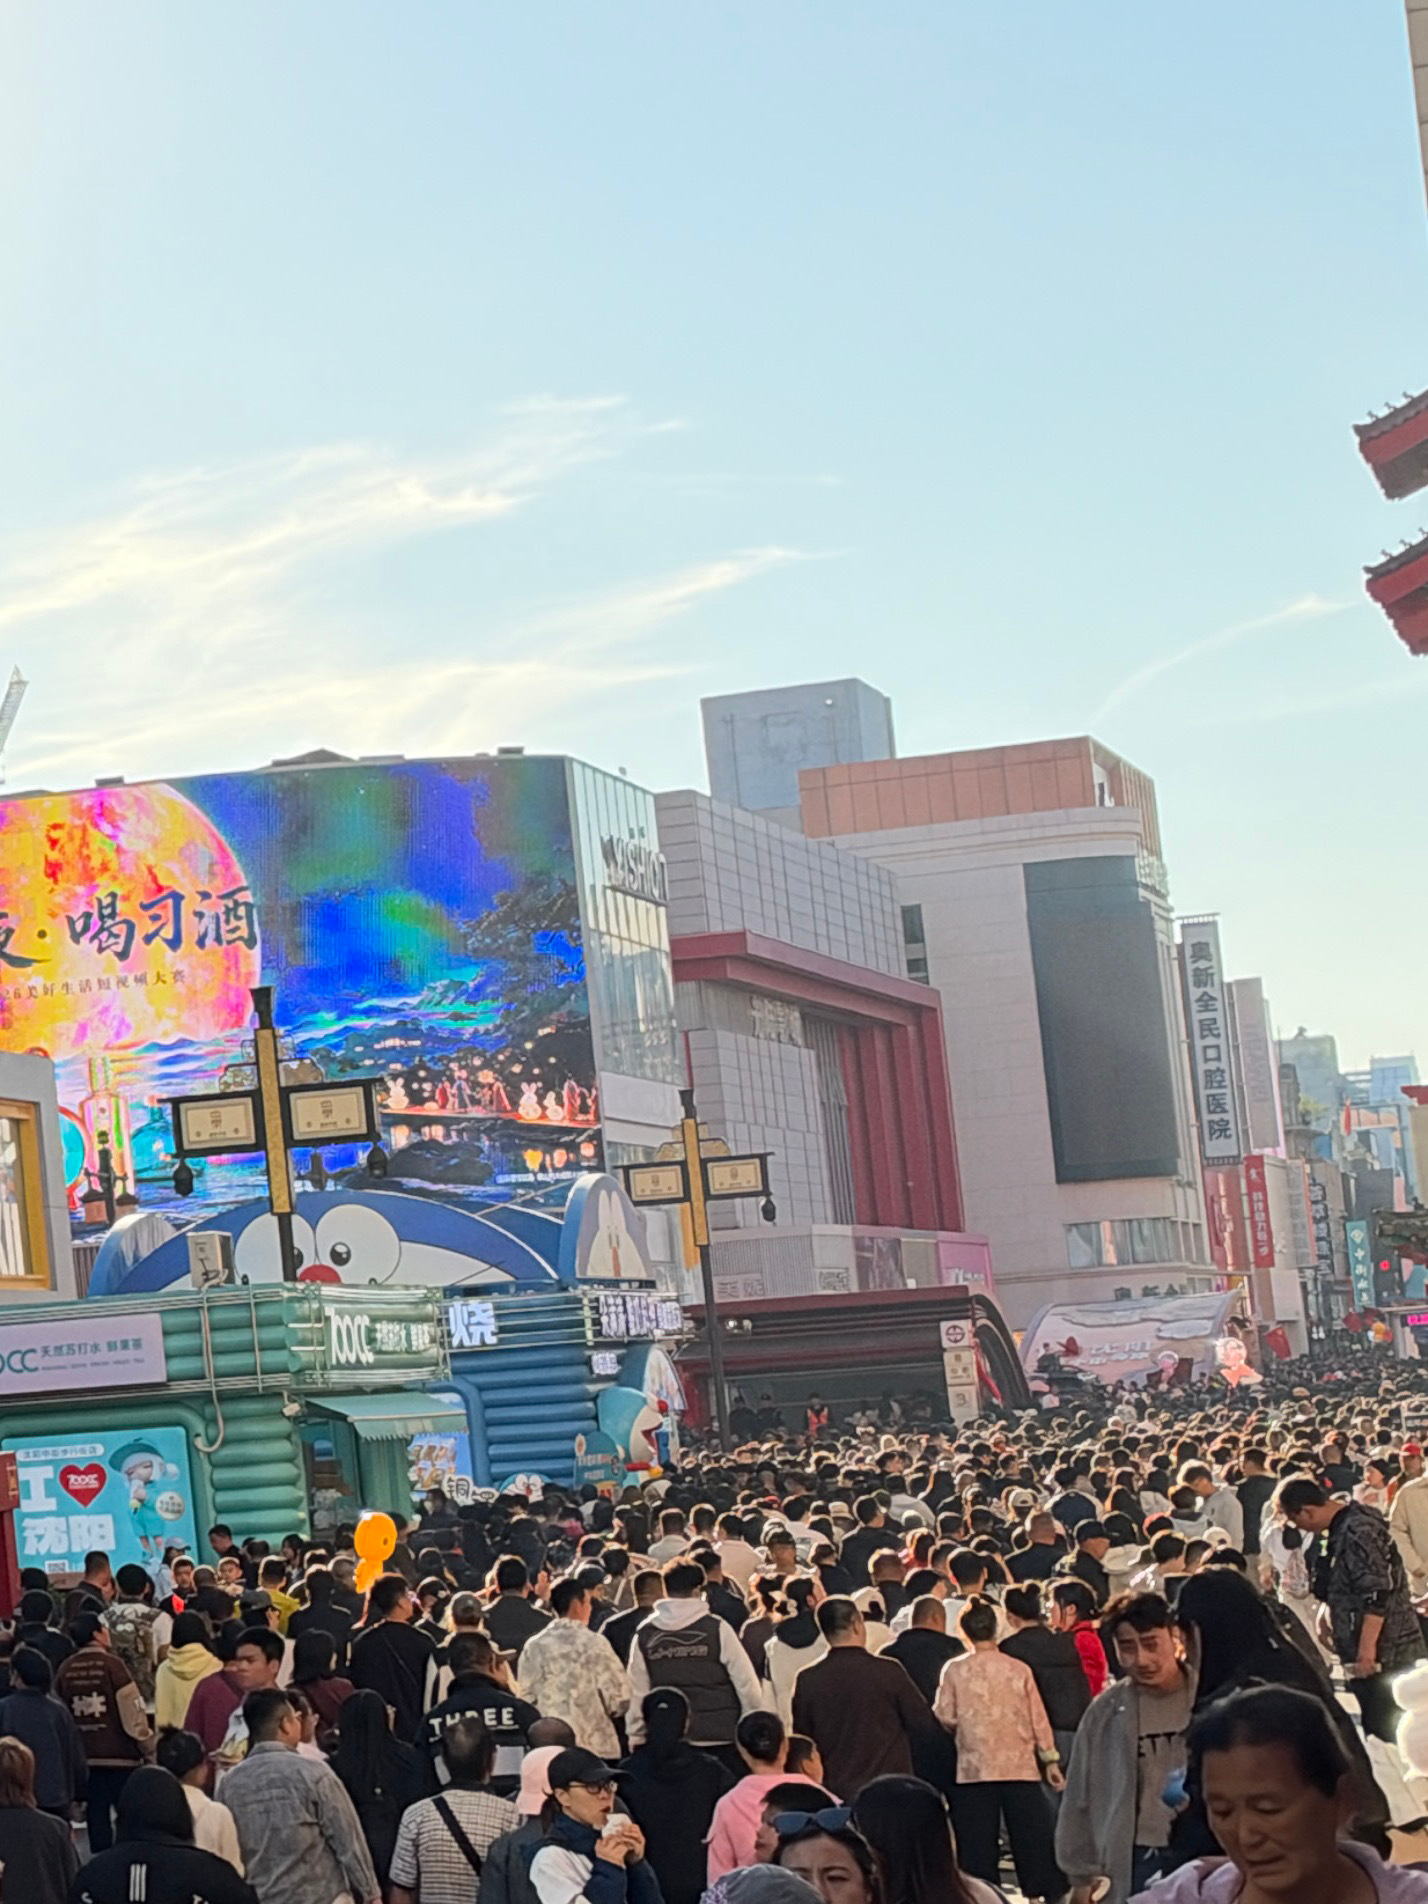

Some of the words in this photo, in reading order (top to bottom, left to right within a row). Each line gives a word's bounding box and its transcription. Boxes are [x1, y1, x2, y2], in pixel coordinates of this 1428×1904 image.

[1189, 940, 1233, 1142] 奥新全民口腔医院
[449, 1301, 497, 1348] 烧
[21, 1513, 117, 1556] 沈阳
